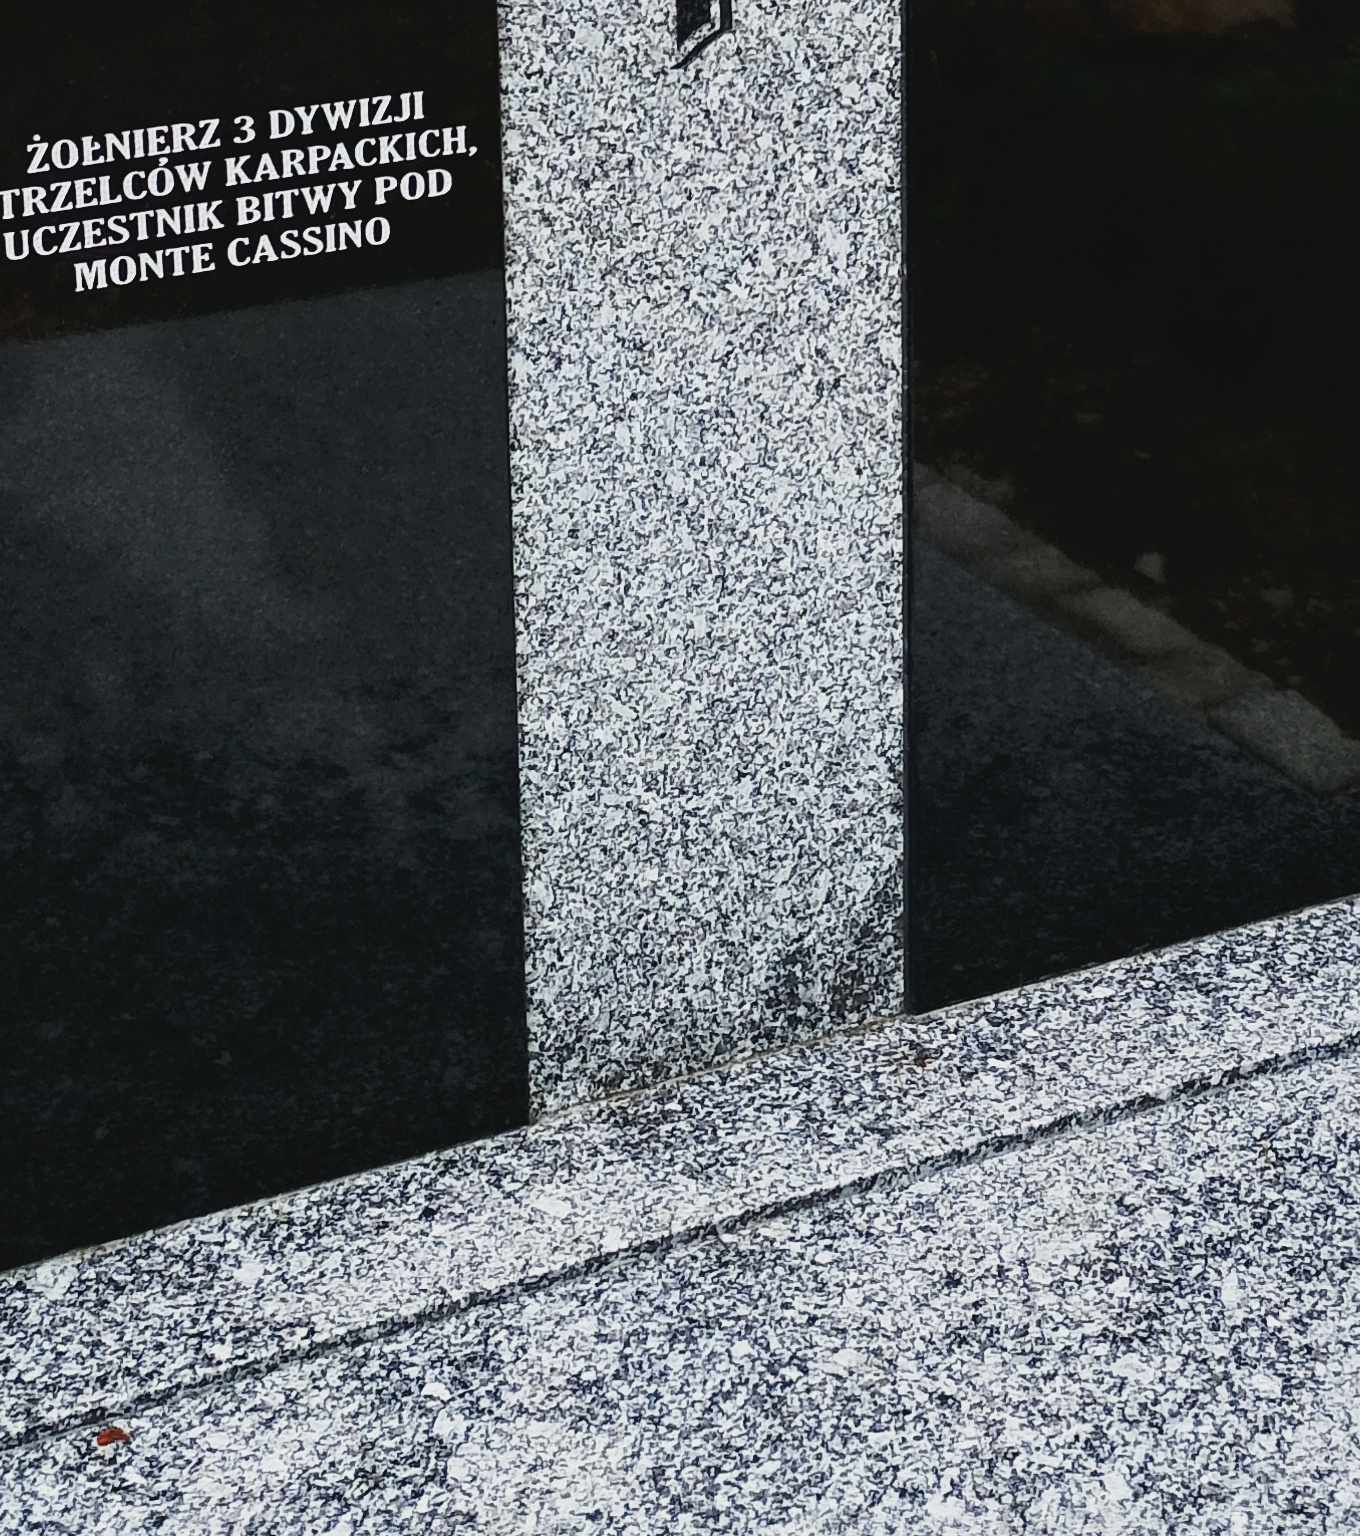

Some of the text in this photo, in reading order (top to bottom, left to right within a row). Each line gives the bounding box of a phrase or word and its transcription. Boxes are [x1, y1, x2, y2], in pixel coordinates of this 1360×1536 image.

[25, 89, 426, 175] ŻOŁNIERZ 3 DYWIZJI
[223, 124, 479, 188] KARPACKICH,
[1, 167, 454, 262] UCZESTNIK BITWY POD
[72, 215, 392, 294] MONTE CASSINO
